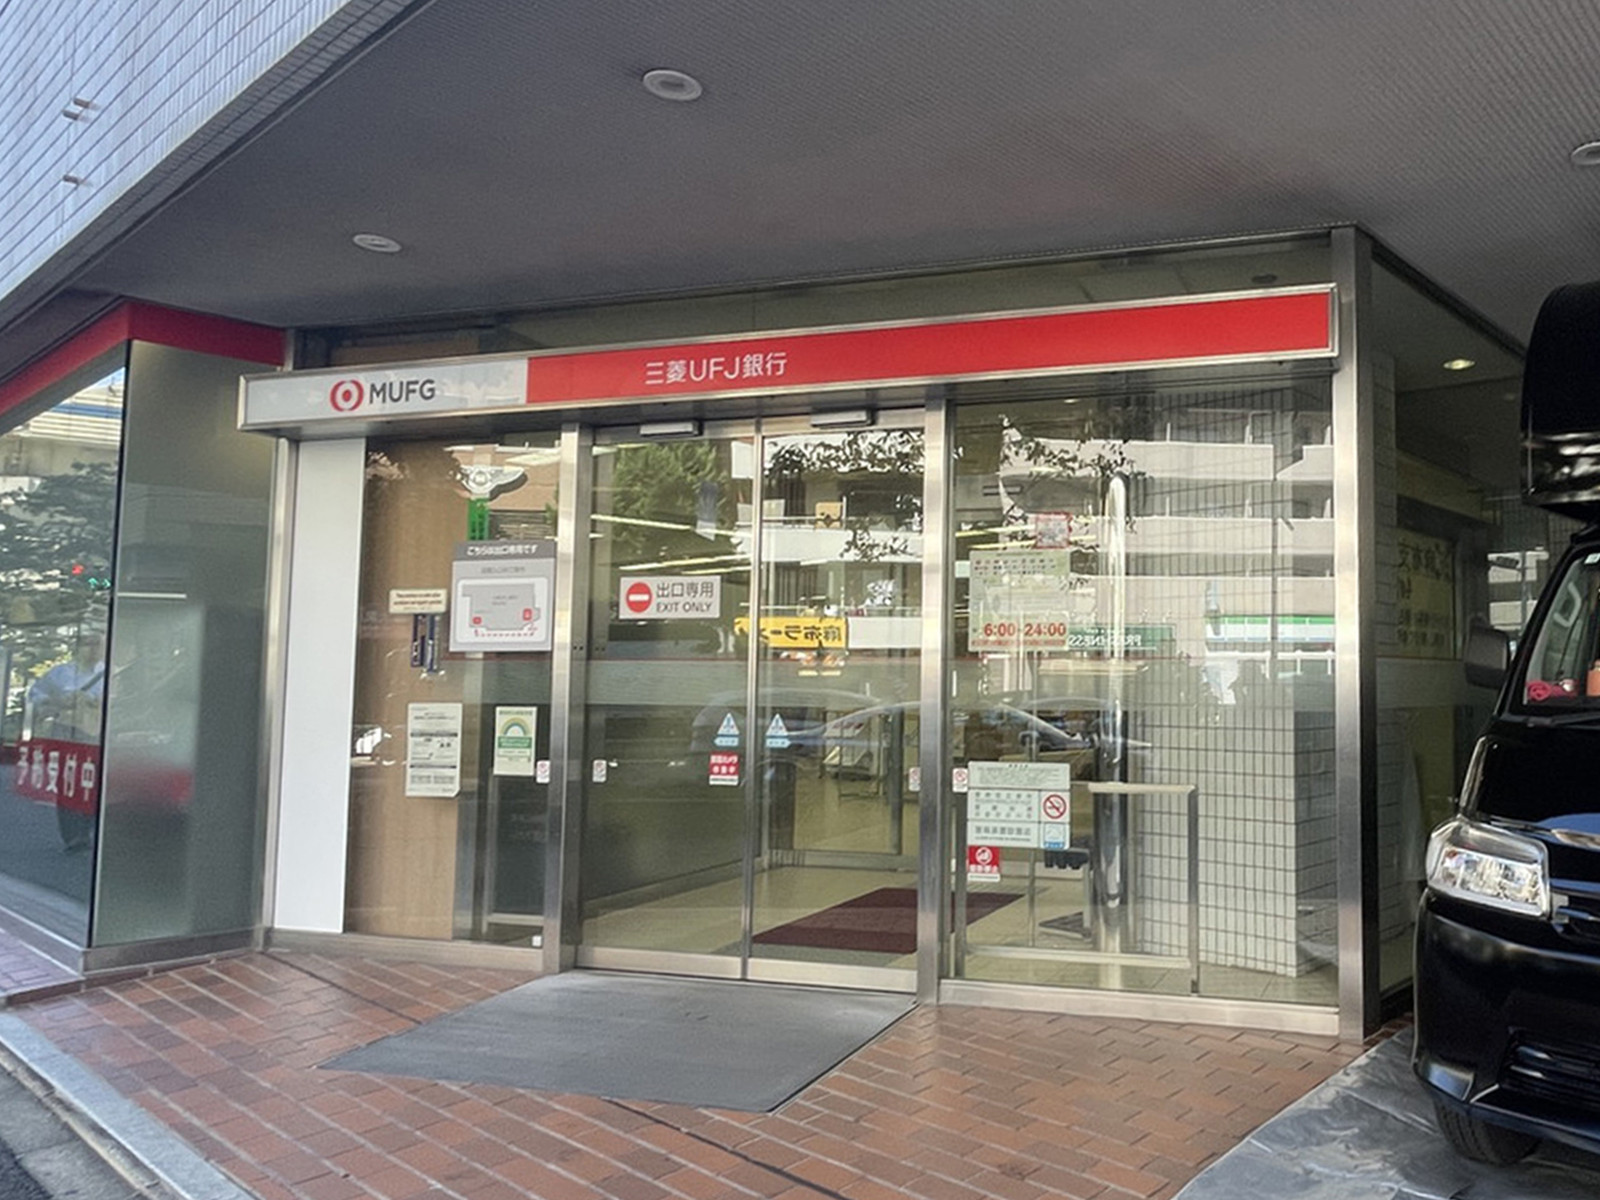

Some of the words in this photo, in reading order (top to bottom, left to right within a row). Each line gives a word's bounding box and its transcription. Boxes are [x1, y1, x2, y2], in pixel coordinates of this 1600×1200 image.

[645, 353, 788, 386] 三菱UFJ銀行
[369, 379, 436, 405] MUFG
[656, 582, 714, 599] 出口専用
[656, 600, 679, 613] EXIT
[682, 600, 713, 613] ONLY
